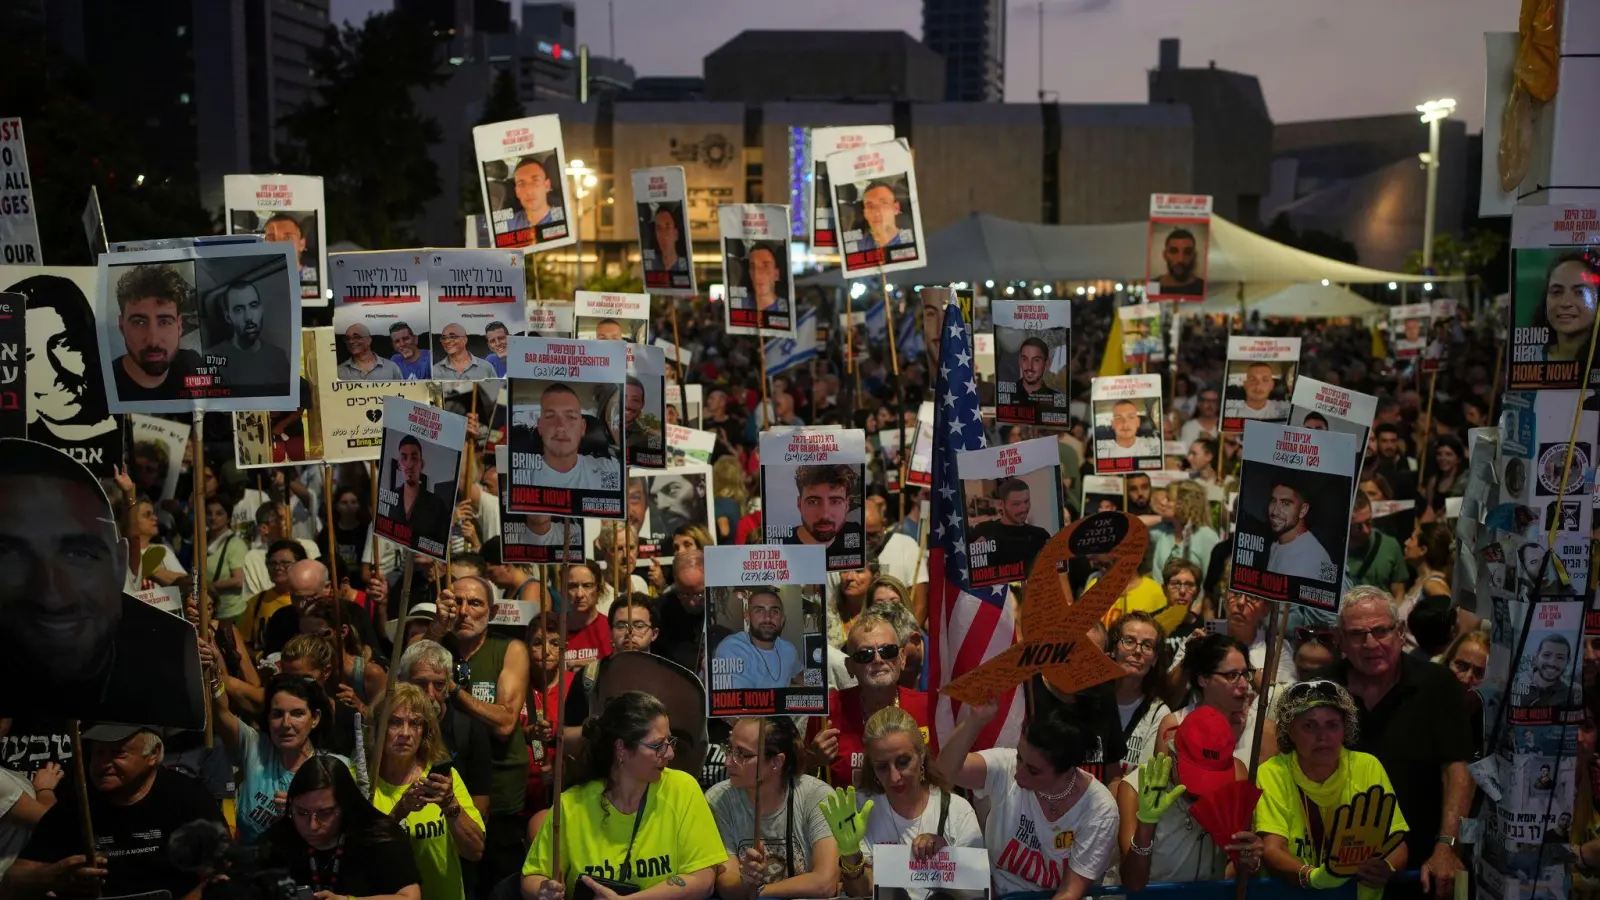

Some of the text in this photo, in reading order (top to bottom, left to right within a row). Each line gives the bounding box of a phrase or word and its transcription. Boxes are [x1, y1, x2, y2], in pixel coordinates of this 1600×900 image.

[0, 121, 19, 141] ST
[6, 172, 29, 189] ALL
[0, 195, 29, 214] GES
[1576, 221, 1600, 232] HAYMA
[5, 245, 36, 263] OUR
[353, 268, 407, 283] טל וליאור
[449, 267, 502, 283] טל וליאור
[345, 284, 417, 299] חייבים לחזור
[440, 284, 512, 299] חייבים לחזור
[1514, 327, 1549, 344] BRING
[525, 353, 610, 367] BAR ABRAHAM KUPERSHTEIN
[1512, 361, 1579, 381] HOME NOW!
[998, 381, 1016, 393] BRING
[998, 393, 1011, 405] HIM
[788, 444, 839, 452] GUY GILBOA-DALAL
[1276, 440, 1318, 456] EVIATAR DAVID
[512, 452, 542, 470] BRING
[512, 469, 532, 485] HIM
[379, 488, 399, 507] BRING
[512, 487, 571, 506] HOME NOW!
[378, 501, 390, 517] HIM
[504, 522, 526, 534] BRING
[766, 525, 793, 538] BRING
[505, 533, 520, 545] HIM
[1238, 532, 1264, 552] BRING
[969, 540, 996, 555] BRING
[742, 560, 787, 570] SEGEV KALFON
[970, 554, 988, 568] HIM
[1236, 548, 1254, 567] HIM
[971, 561, 1024, 582] HOME NOW!
[1234, 565, 1288, 593] HOME NOW!
[1586, 611, 1600, 628] NO
[577, 648, 599, 659] EITAN
[711, 658, 744, 674] BRING
[711, 674, 733, 689] HIM
[712, 690, 774, 708] HOME NOW!
[851, 753, 864, 768] BR
[415, 818, 445, 839] אתם
[1528, 825, 1540, 840] לך
[637, 855, 672, 878] אתם
[930, 862, 957, 872] ANGREST
